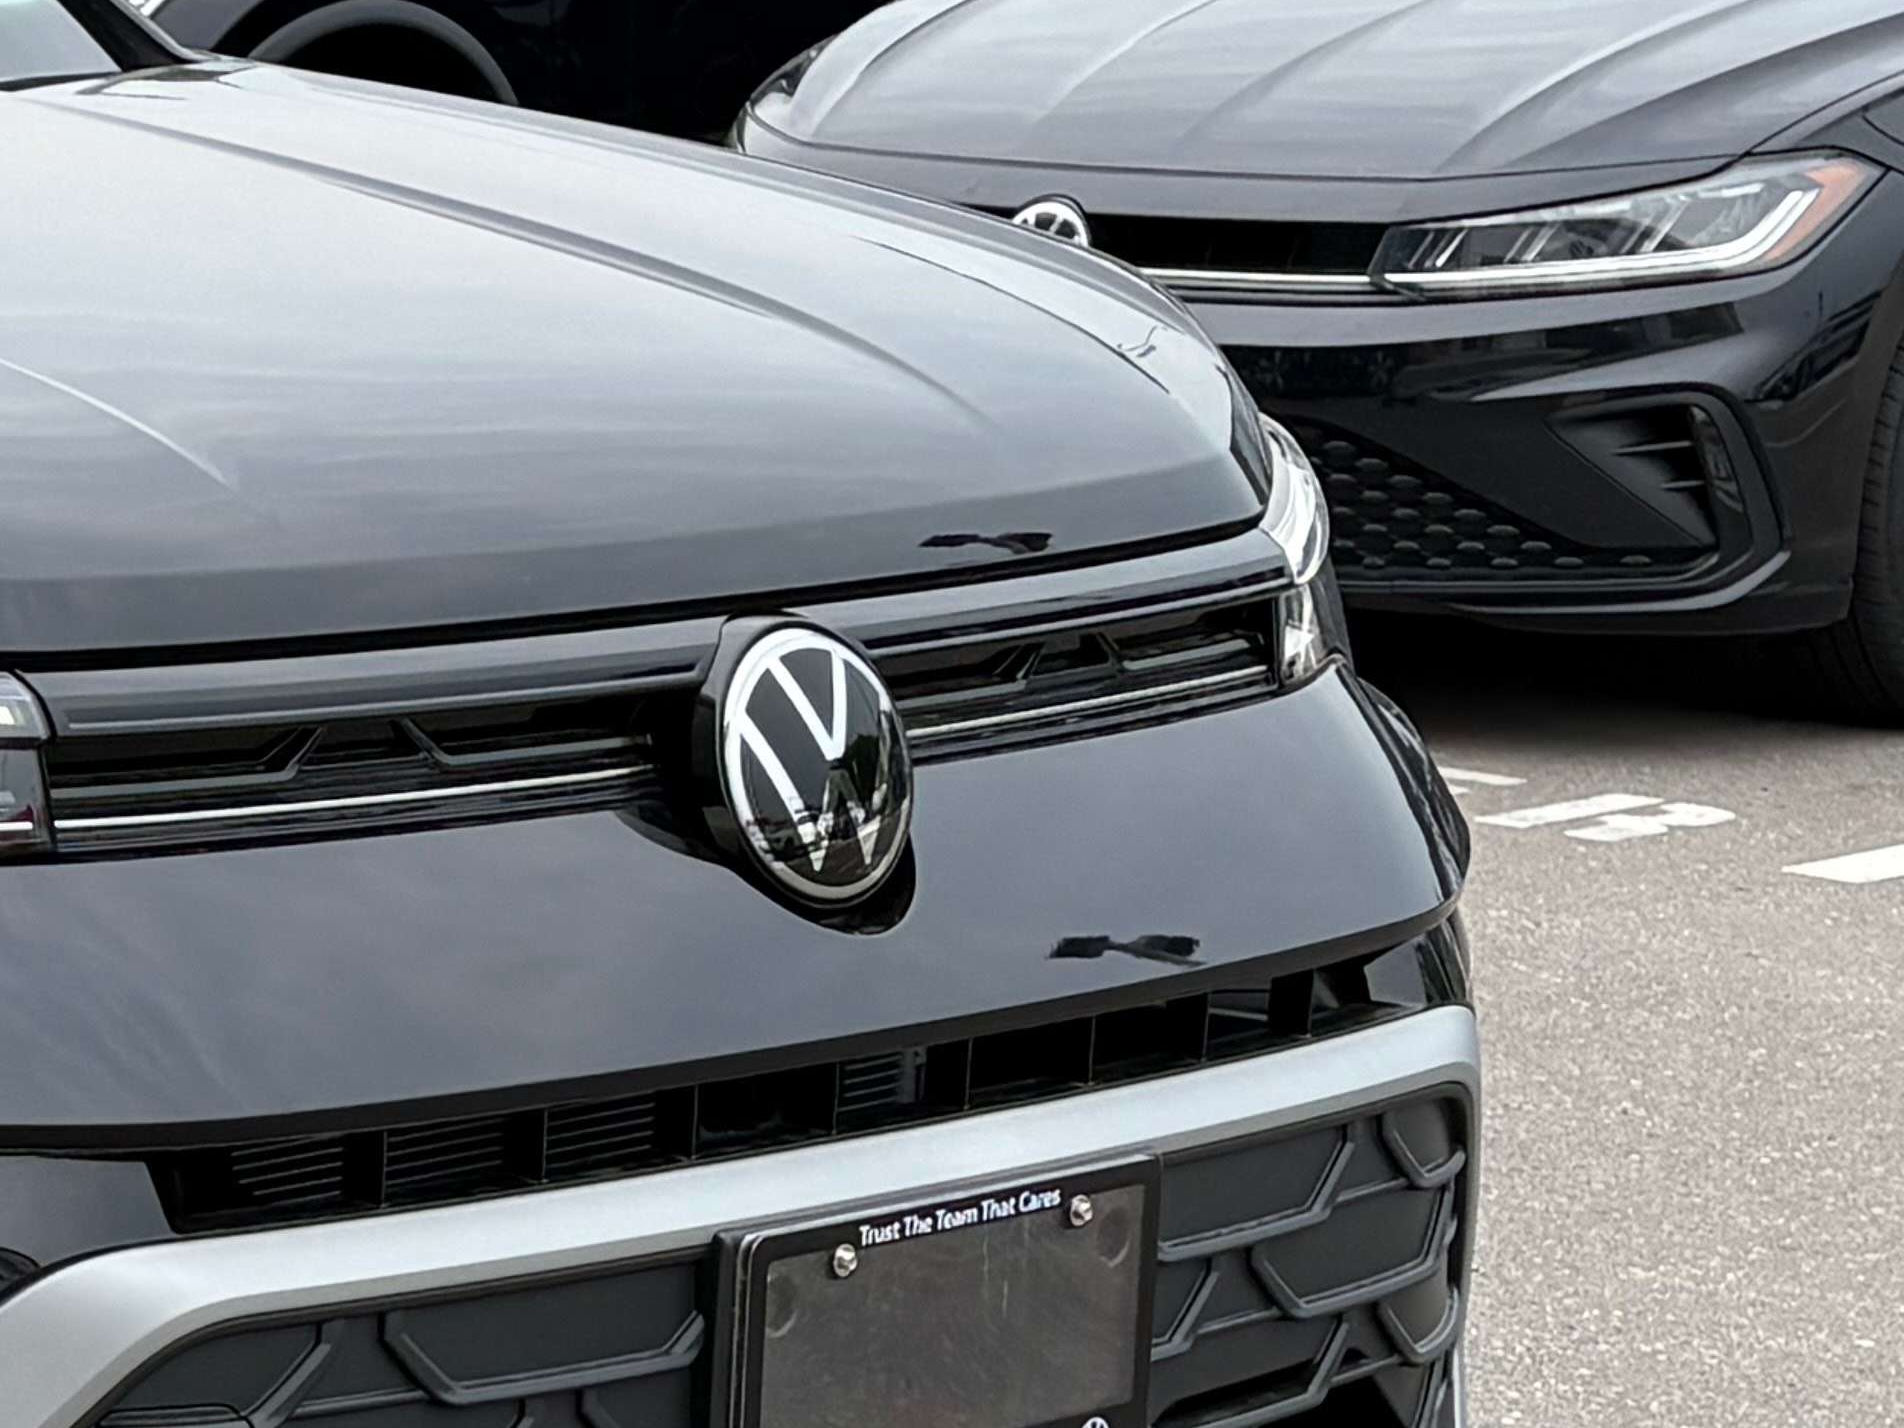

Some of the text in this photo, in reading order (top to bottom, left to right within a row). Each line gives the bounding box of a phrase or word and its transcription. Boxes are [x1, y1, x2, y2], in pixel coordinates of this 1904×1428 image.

[859, 1188, 1061, 1247] Trust The Team That Cares
